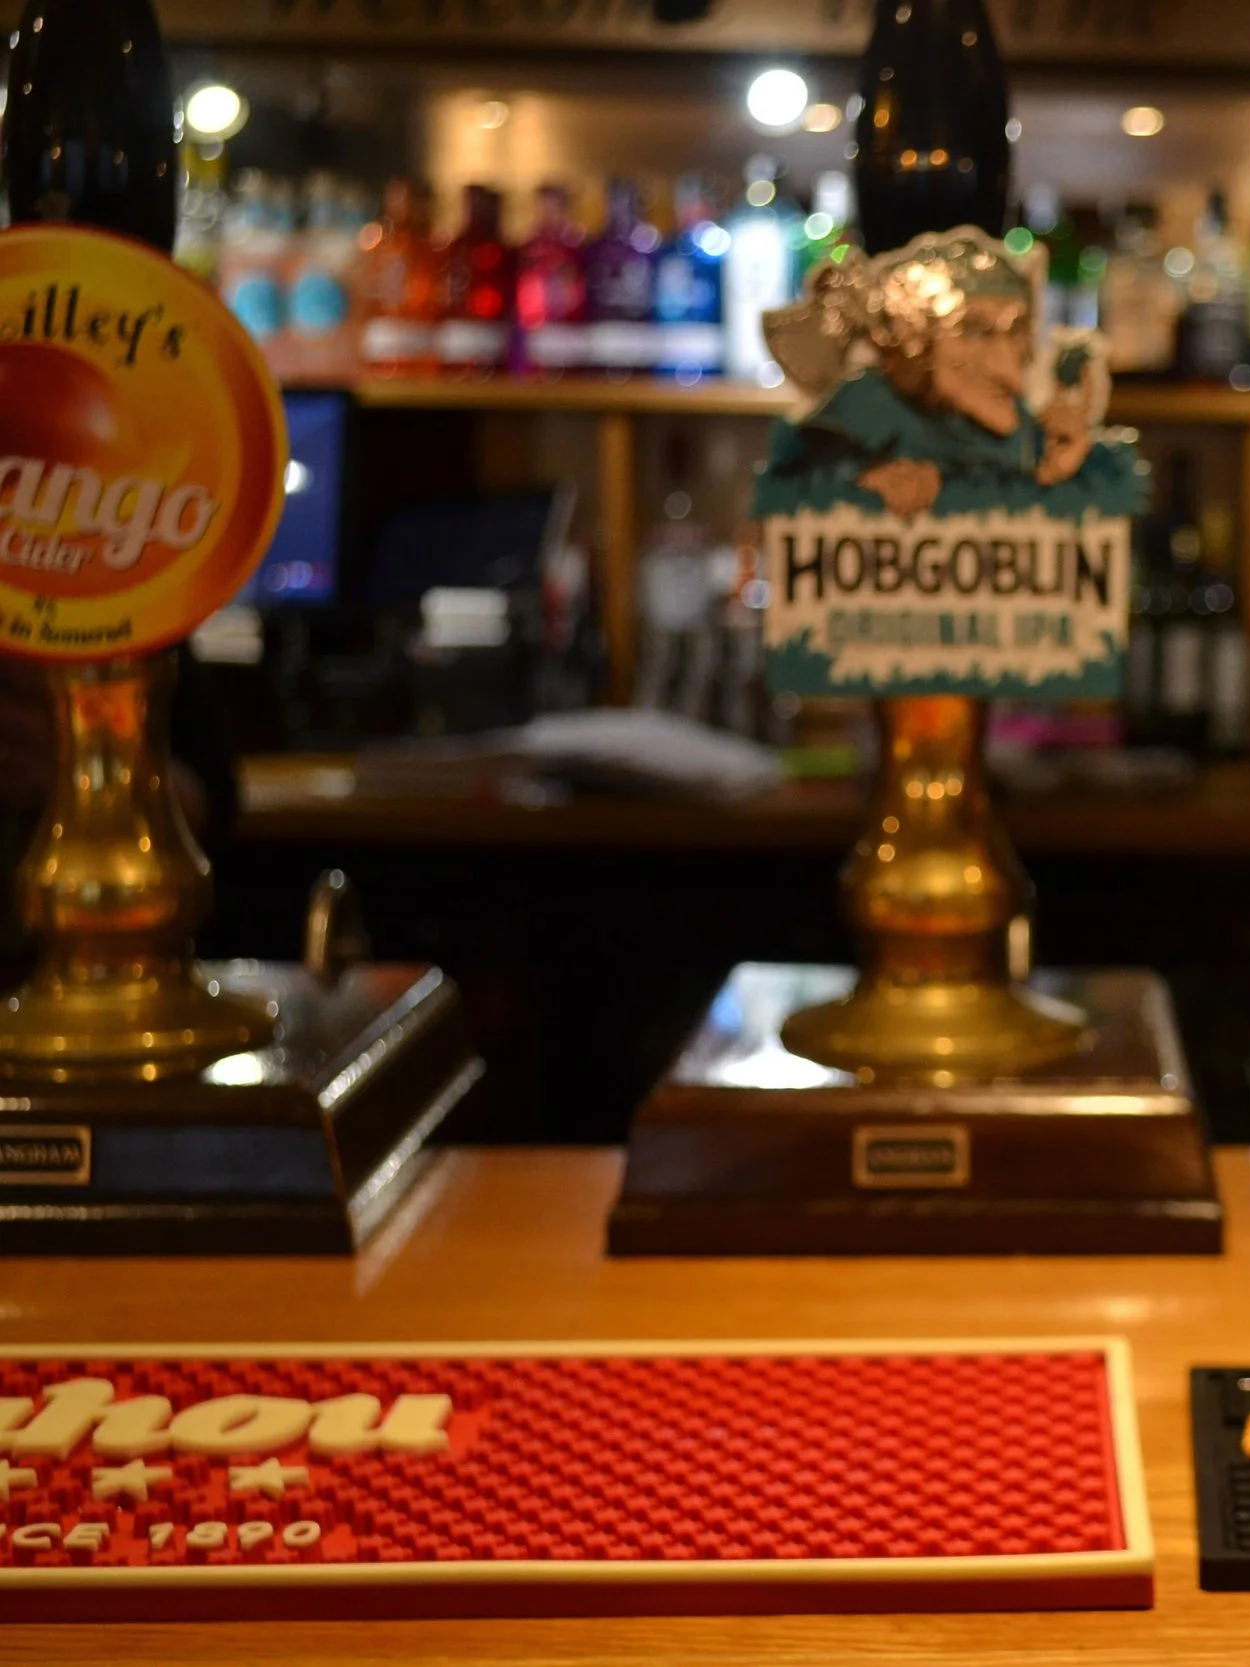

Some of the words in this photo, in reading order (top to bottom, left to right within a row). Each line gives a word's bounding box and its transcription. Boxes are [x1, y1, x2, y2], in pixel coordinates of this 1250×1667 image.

[784, 534, 1111, 607] HOBGOBLIN
[1013, 610, 1072, 647] IPA
[148, 1519, 322, 1549] 1890
